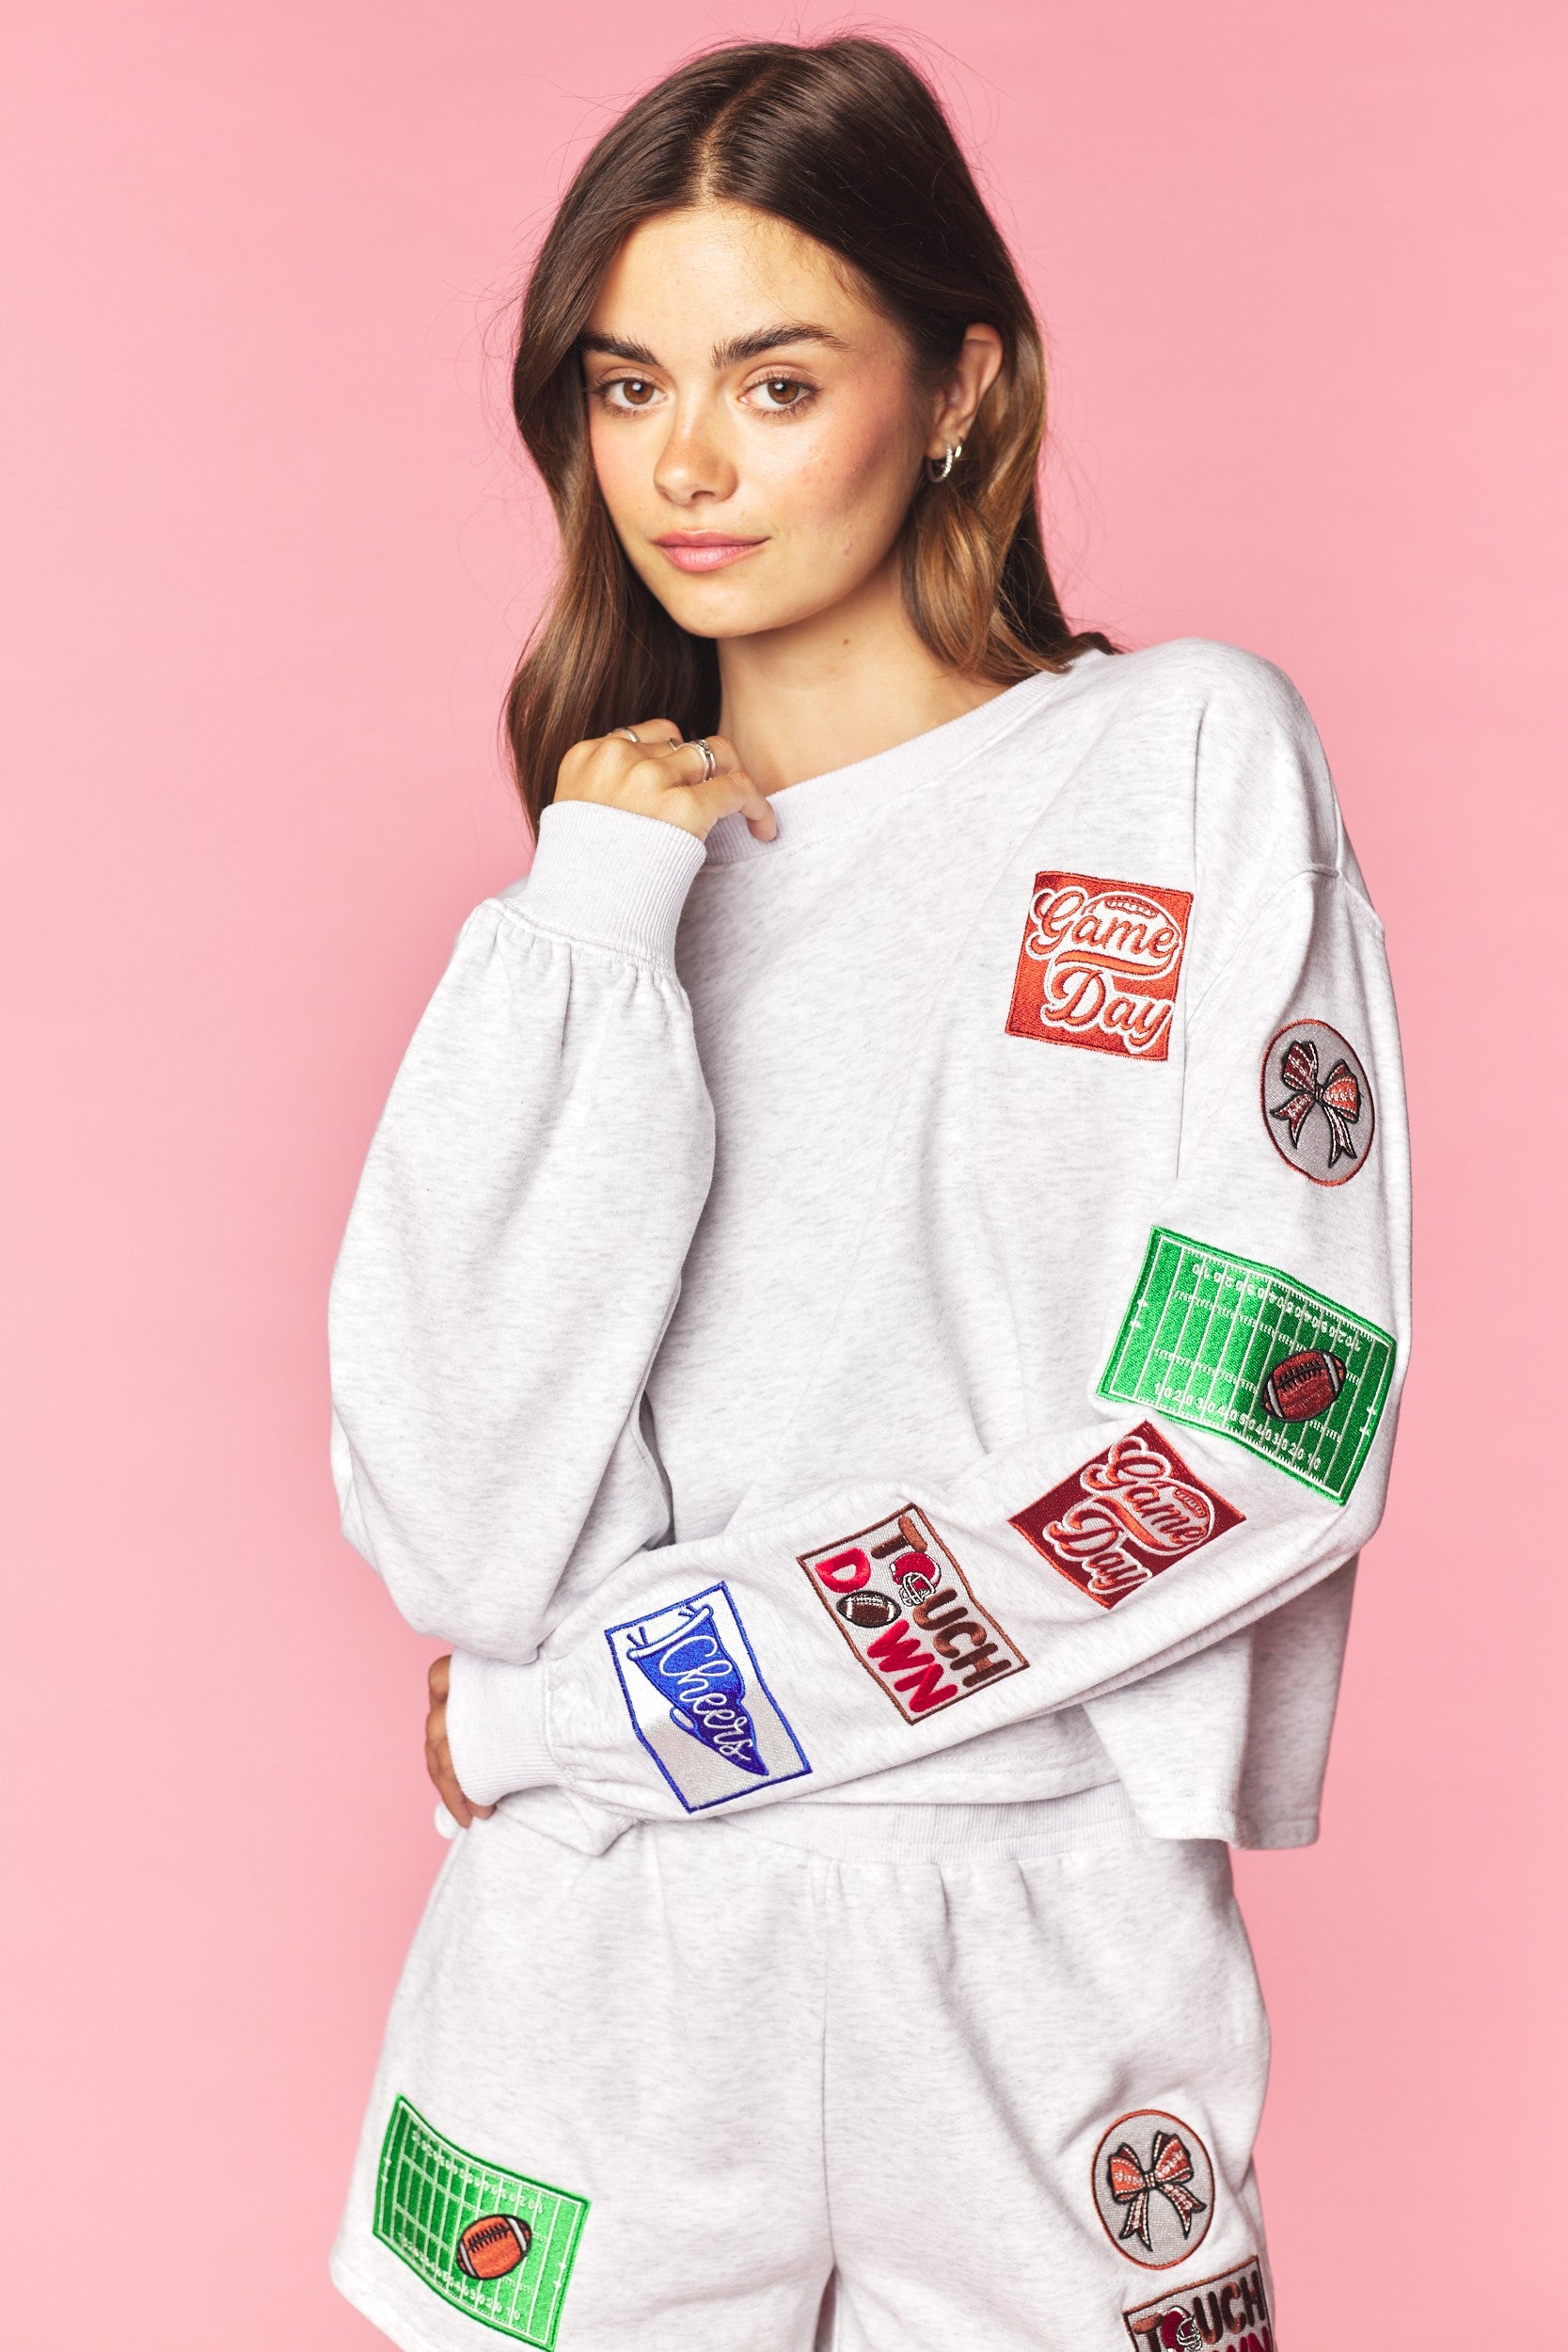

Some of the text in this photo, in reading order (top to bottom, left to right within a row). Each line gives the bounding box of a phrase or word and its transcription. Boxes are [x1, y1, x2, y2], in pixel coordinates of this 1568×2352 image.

[1029, 889, 1180, 959] Game
[1044, 966, 1172, 1046] Day
[1085, 1438, 1208, 1548] Game
[1048, 1509, 1149, 1591] Day
[659, 1635, 753, 1761] Cheers
